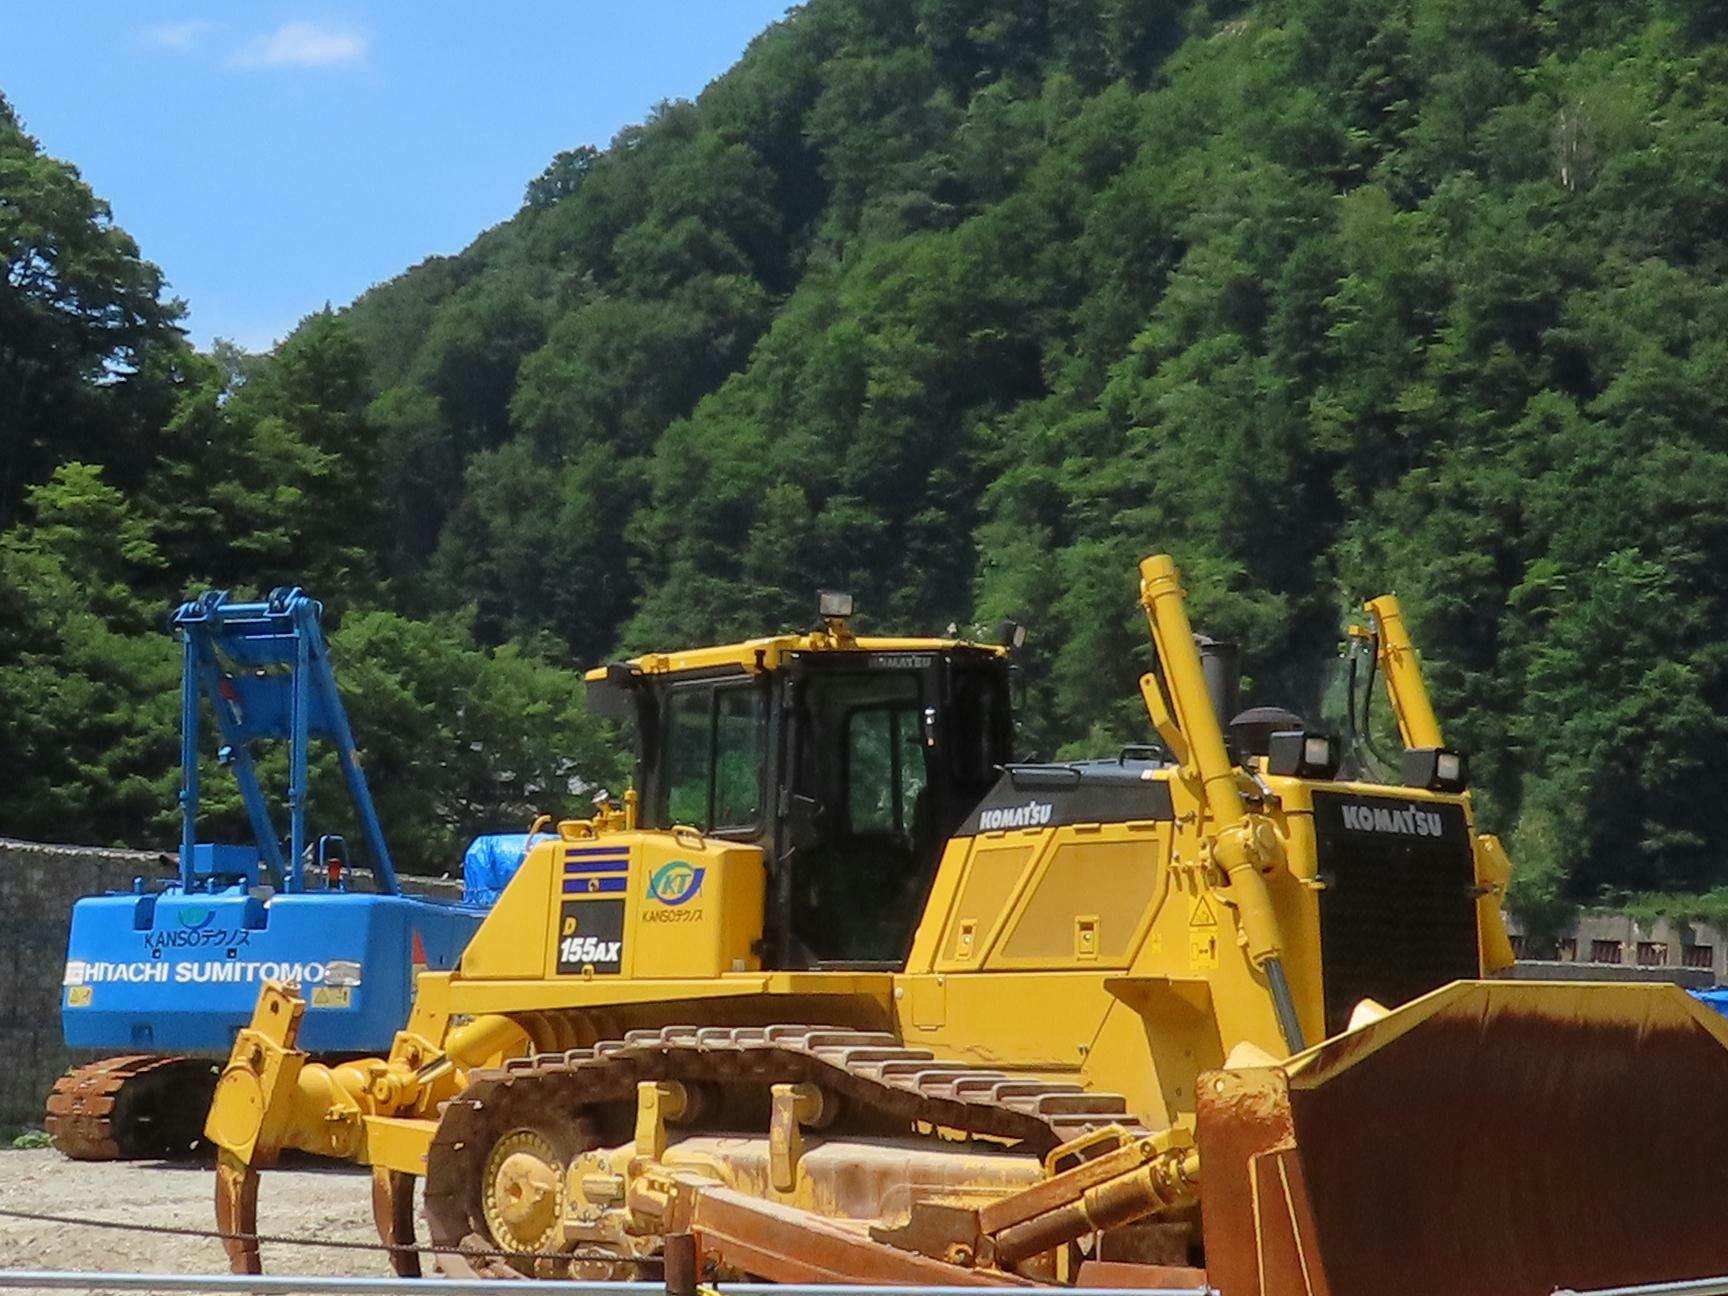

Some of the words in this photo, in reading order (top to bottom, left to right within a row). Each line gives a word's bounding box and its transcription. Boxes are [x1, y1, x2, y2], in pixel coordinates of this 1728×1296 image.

[979, 800, 1052, 831] KOMATSU
[1341, 804, 1443, 837] KOMATSU
[562, 916, 577, 936] D
[642, 908, 703, 923] KANSOテクノス
[144, 929, 250, 949] KANSOテクノス
[560, 937, 621, 963] 155AX
[84, 961, 169, 983] HITACHI
[175, 960, 325, 984] SUMITOMO
